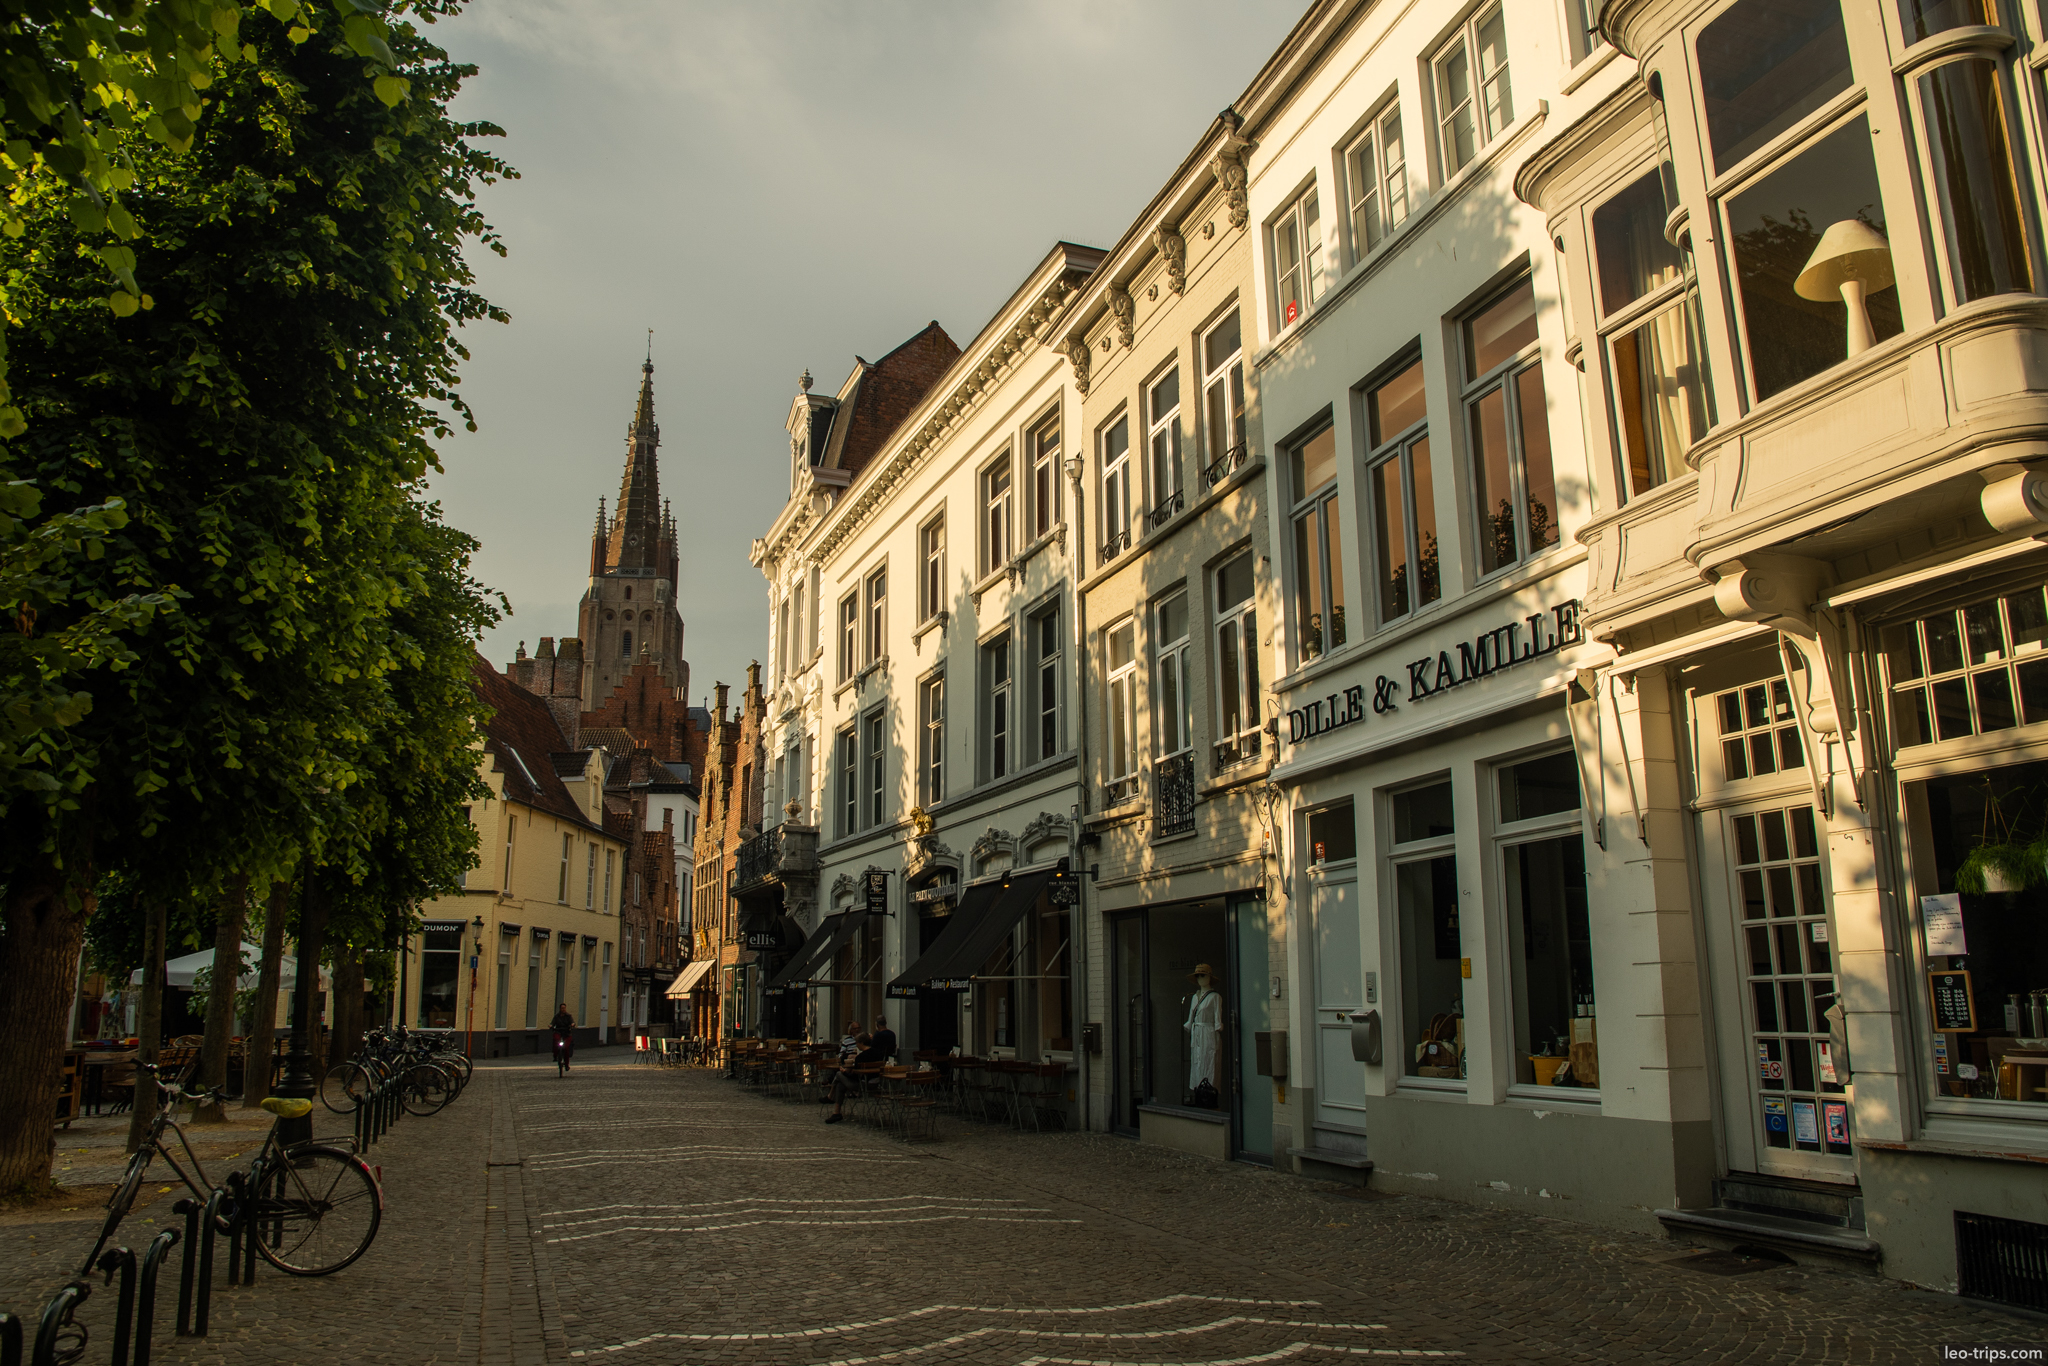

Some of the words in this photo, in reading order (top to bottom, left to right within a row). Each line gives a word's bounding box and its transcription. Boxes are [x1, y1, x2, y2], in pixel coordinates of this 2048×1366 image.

[1286, 684, 1365, 745] DILLE
[1373, 675, 1398, 714] &
[1406, 599, 1584, 703] KAMILLE
[915, 889, 927, 901] PAIN
[749, 933, 776, 945] ellis
[891, 985, 903, 995] Brunch
[906, 986, 917, 996] Lunch
[931, 979, 946, 991] Bakkerij
[950, 978, 969, 988] Restaurant
